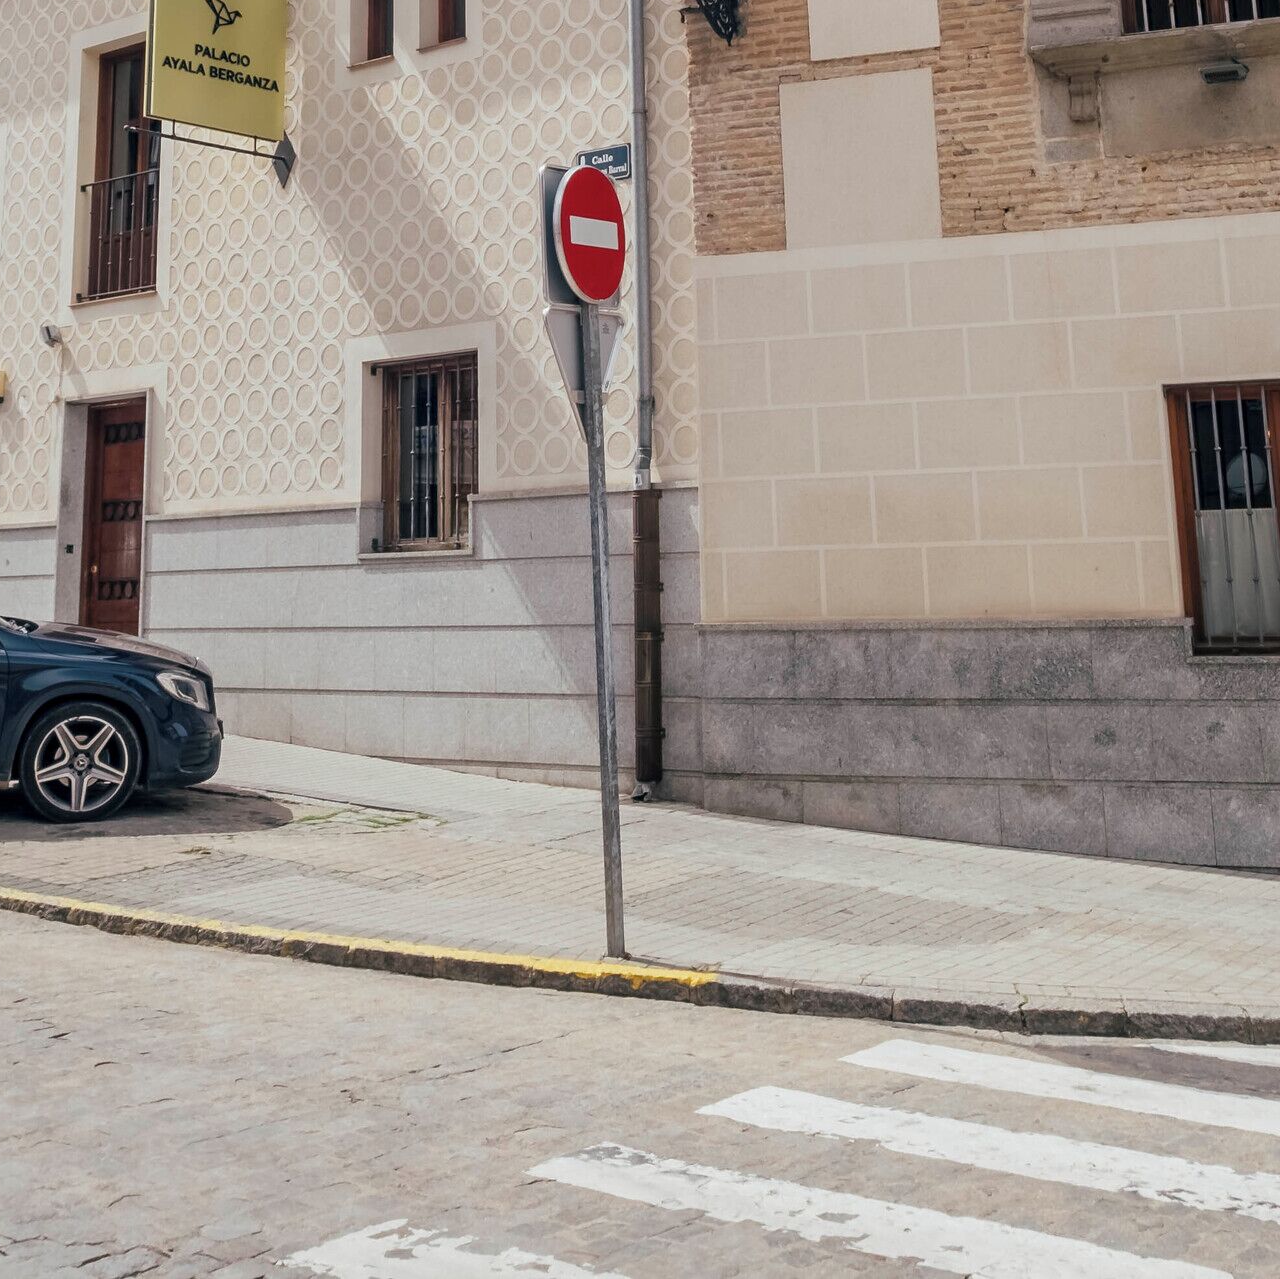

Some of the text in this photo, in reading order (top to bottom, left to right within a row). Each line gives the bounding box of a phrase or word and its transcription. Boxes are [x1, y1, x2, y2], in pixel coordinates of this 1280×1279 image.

[194, 44, 250, 67] PALACIO
[162, 55, 280, 93] AYALA BERGANZA
[592, 154, 613, 165] Calle
